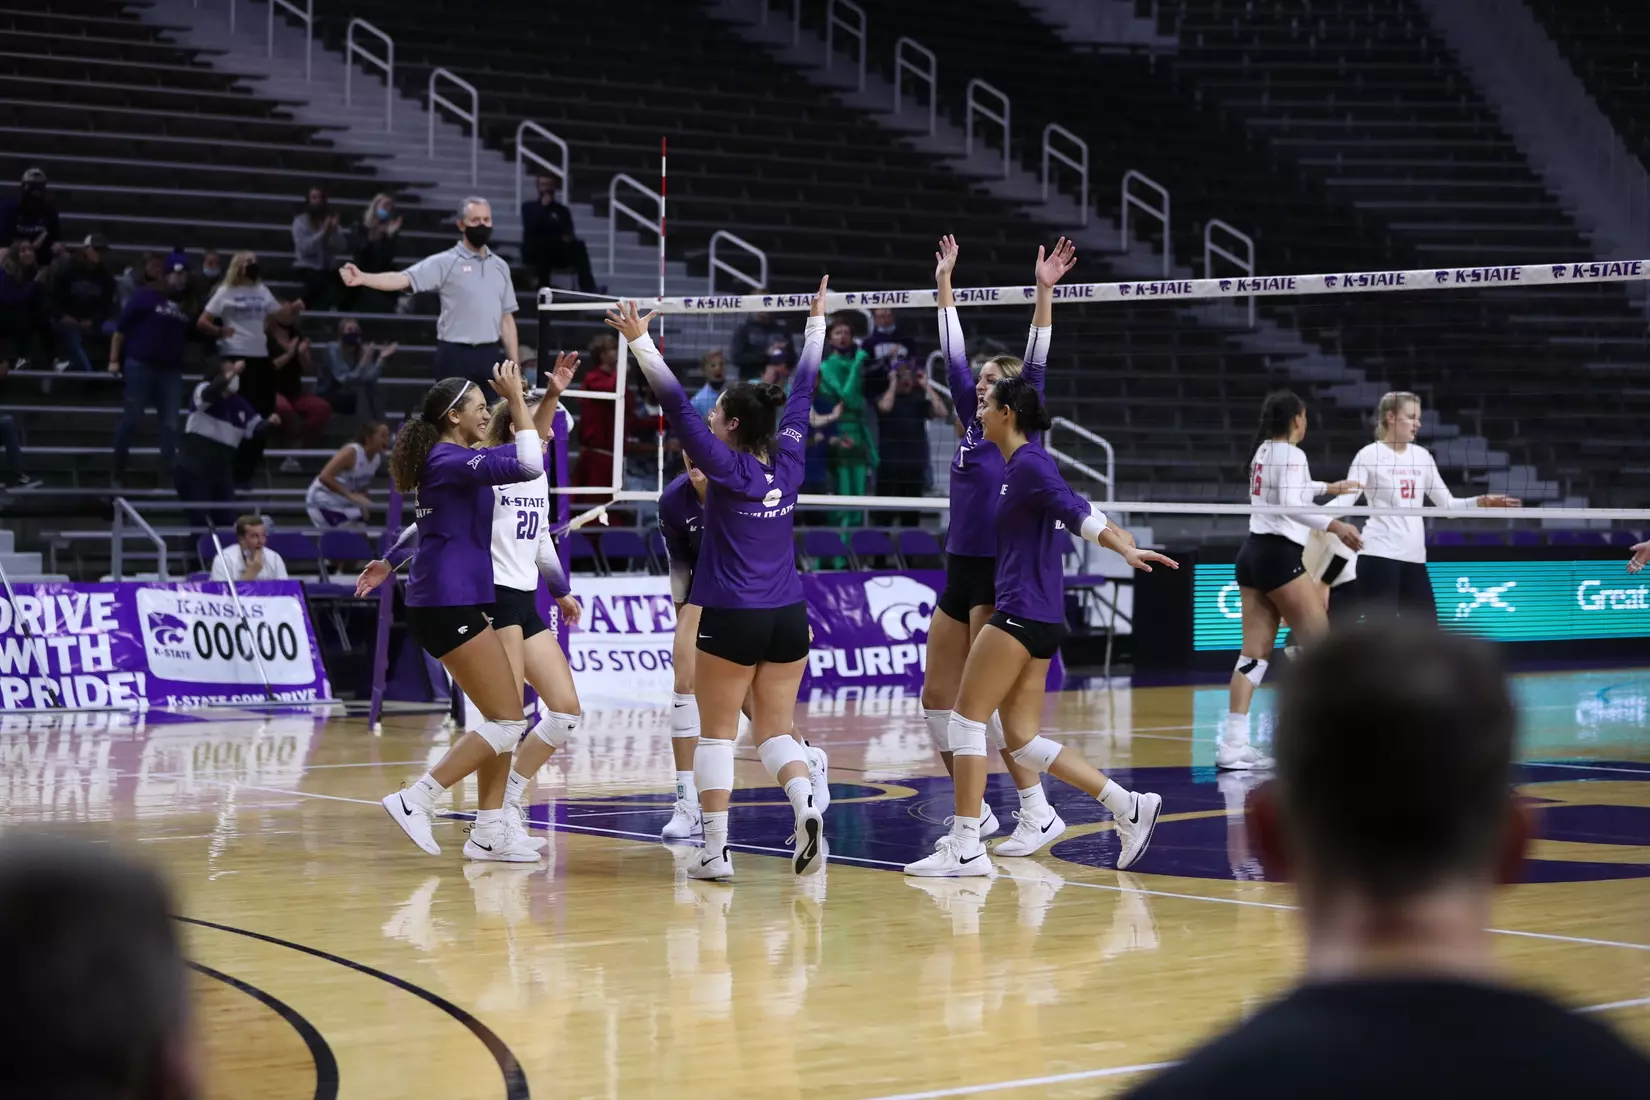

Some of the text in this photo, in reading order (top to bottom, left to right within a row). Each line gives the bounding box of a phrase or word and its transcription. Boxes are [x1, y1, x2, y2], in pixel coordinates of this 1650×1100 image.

[1456, 267, 1521, 283] K-STATE
[1572, 261, 1643, 278] K-STATE
[1237, 278, 1296, 292] K-STATE
[1343, 273, 1406, 287] K-STATE
[1136, 282, 1193, 295] K-STATE
[696, 298, 742, 309] K-STATE
[860, 292, 910, 305] K-STATE
[1399, 479, 1416, 499] 21
[501, 496, 545, 508] K-STATE
[516, 510, 539, 540] 20
[1577, 580, 1650, 611] Great
[178, 599, 264, 618] KANSAS
[193, 620, 298, 662] 00000
[0, 633, 113, 675] WITH
[154, 647, 191, 660] K-STATE
[1, 671, 150, 712] PRIDE!
